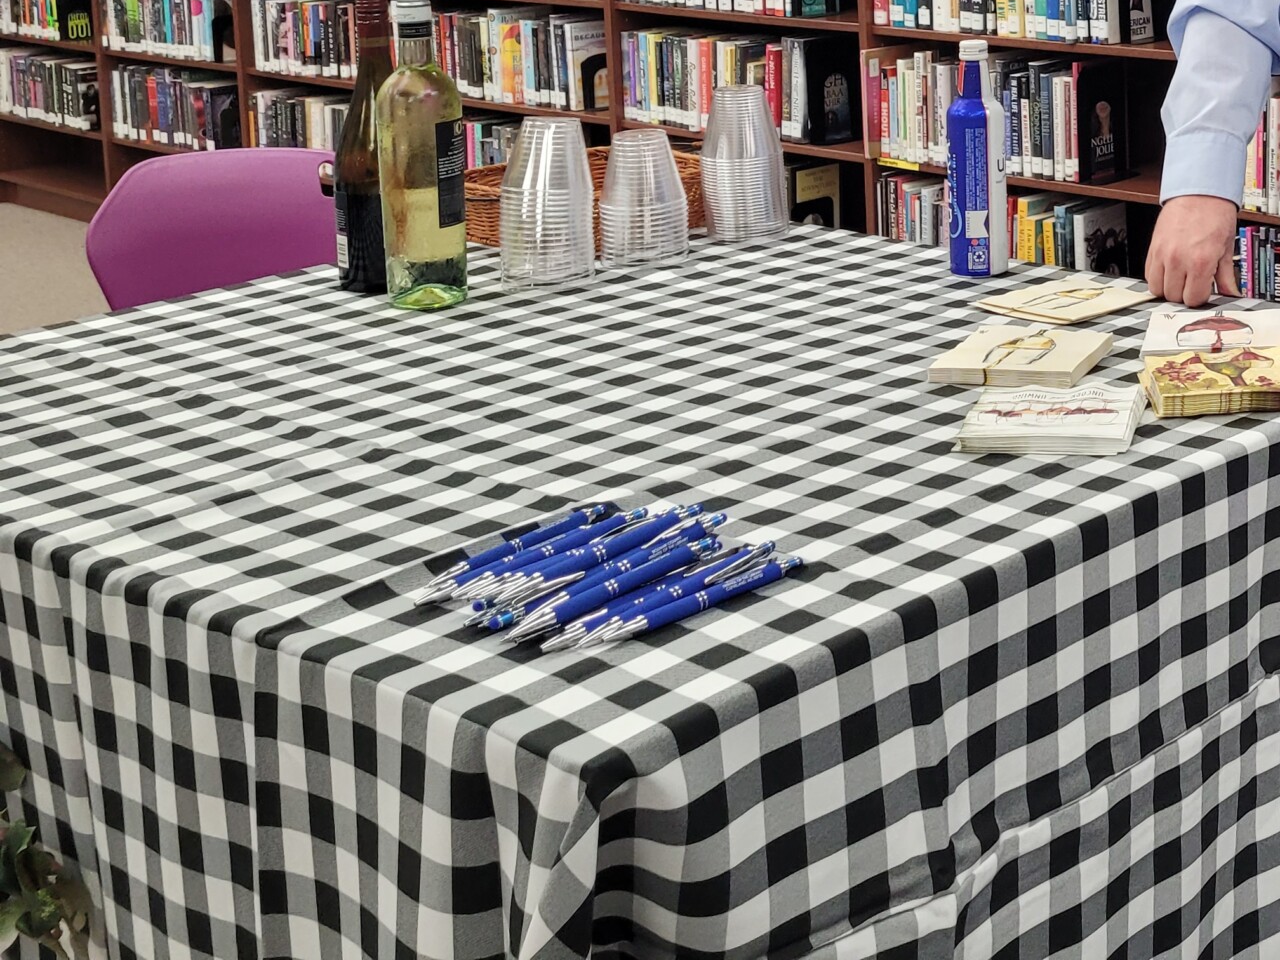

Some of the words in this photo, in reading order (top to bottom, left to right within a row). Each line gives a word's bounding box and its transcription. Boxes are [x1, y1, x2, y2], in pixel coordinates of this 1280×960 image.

[1040, 91, 1049, 119] HIDDEN
[880, 102, 888, 140] SHOUT
[1033, 101, 1041, 146] ORDINARY
[1041, 120, 1050, 136] GIRL
[1240, 237, 1248, 259] DAN
[1240, 261, 1248, 285] PHIL
